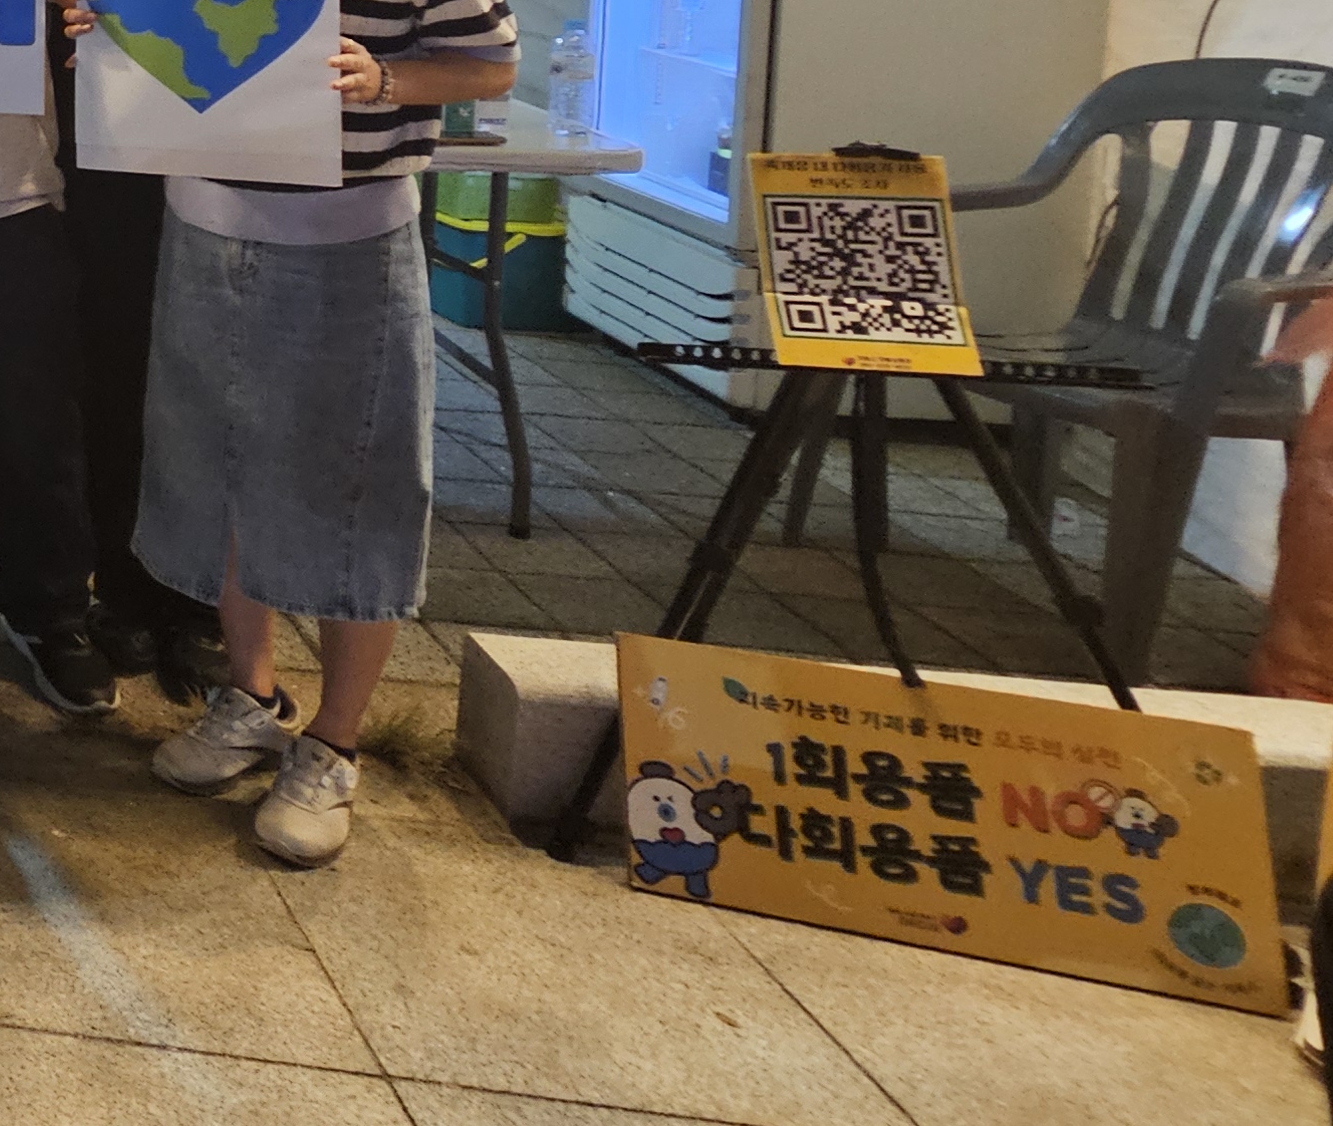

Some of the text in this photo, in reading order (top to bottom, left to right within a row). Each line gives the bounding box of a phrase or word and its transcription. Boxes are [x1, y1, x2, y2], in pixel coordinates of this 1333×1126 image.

[765, 734, 1106, 840] 1회용품 NO
[937, 722, 984, 748] 위한
[742, 801, 1145, 925] 다회용품 YES
